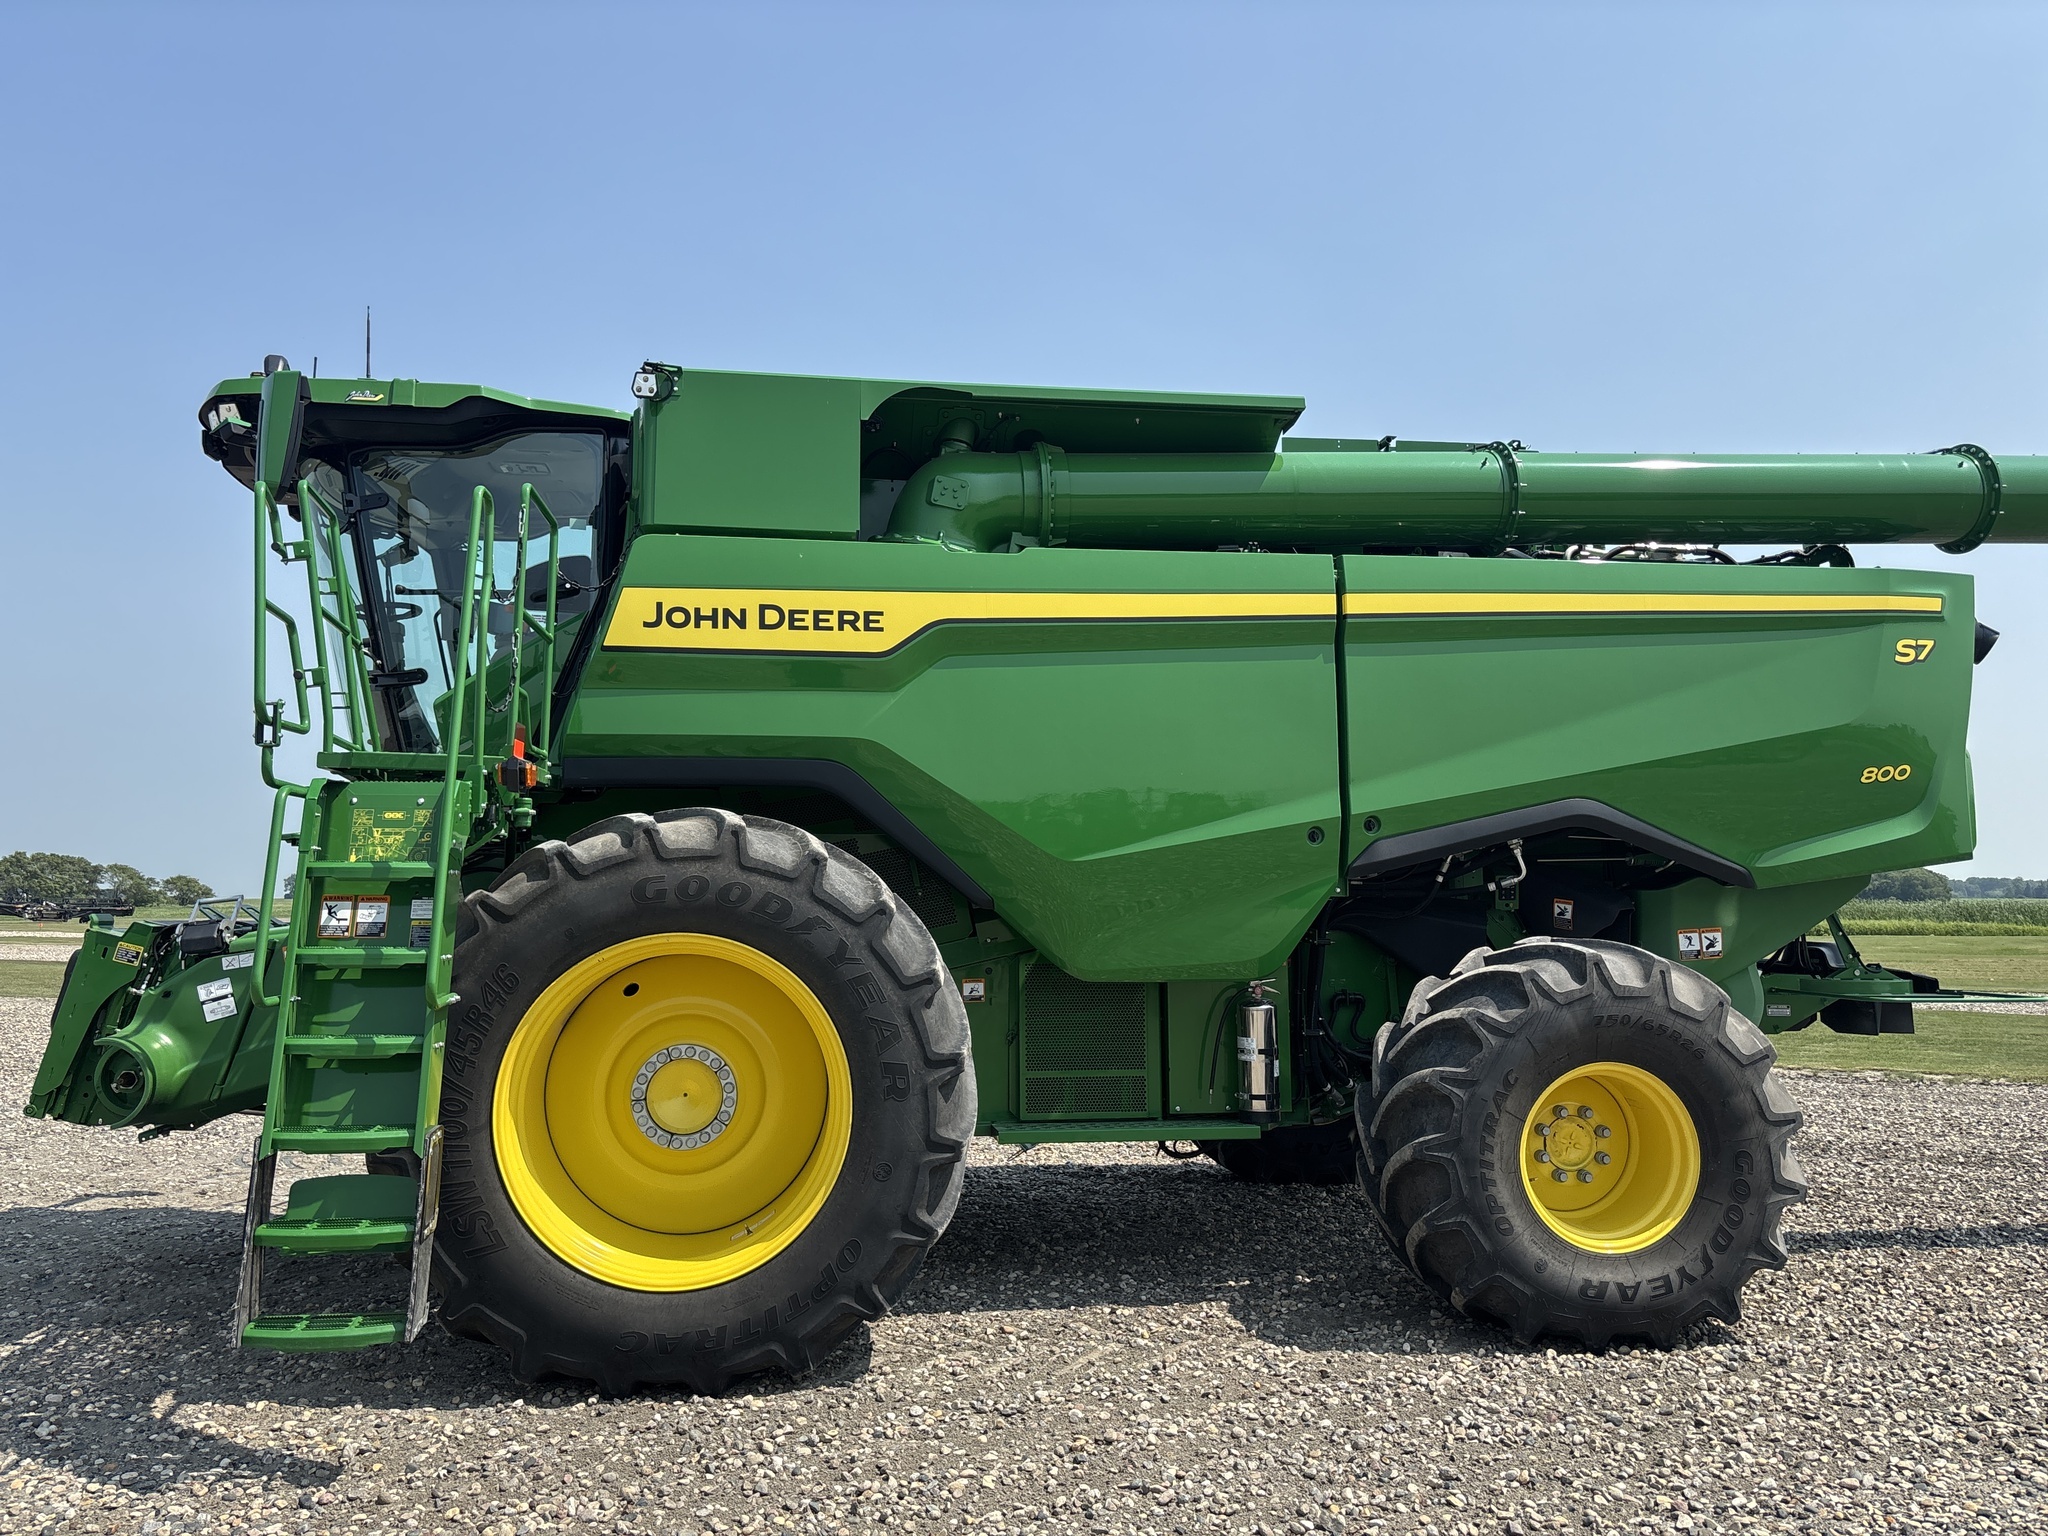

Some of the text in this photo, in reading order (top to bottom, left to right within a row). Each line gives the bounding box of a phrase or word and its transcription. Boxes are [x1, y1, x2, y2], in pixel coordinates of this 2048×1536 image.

[643, 601, 885, 632] JOHN DEERE
[1893, 638, 1936, 665] S7
[1860, 764, 1911, 784] 800
[631, 874, 912, 1102] GOODYEAR
[1593, 1014, 1706, 1060] 750/65R26
[1479, 1068, 1519, 1237] OPTITRAC
[1578, 1149, 1753, 1304] GOODYEAR
[613, 1238, 863, 1356] OPTITRAC
